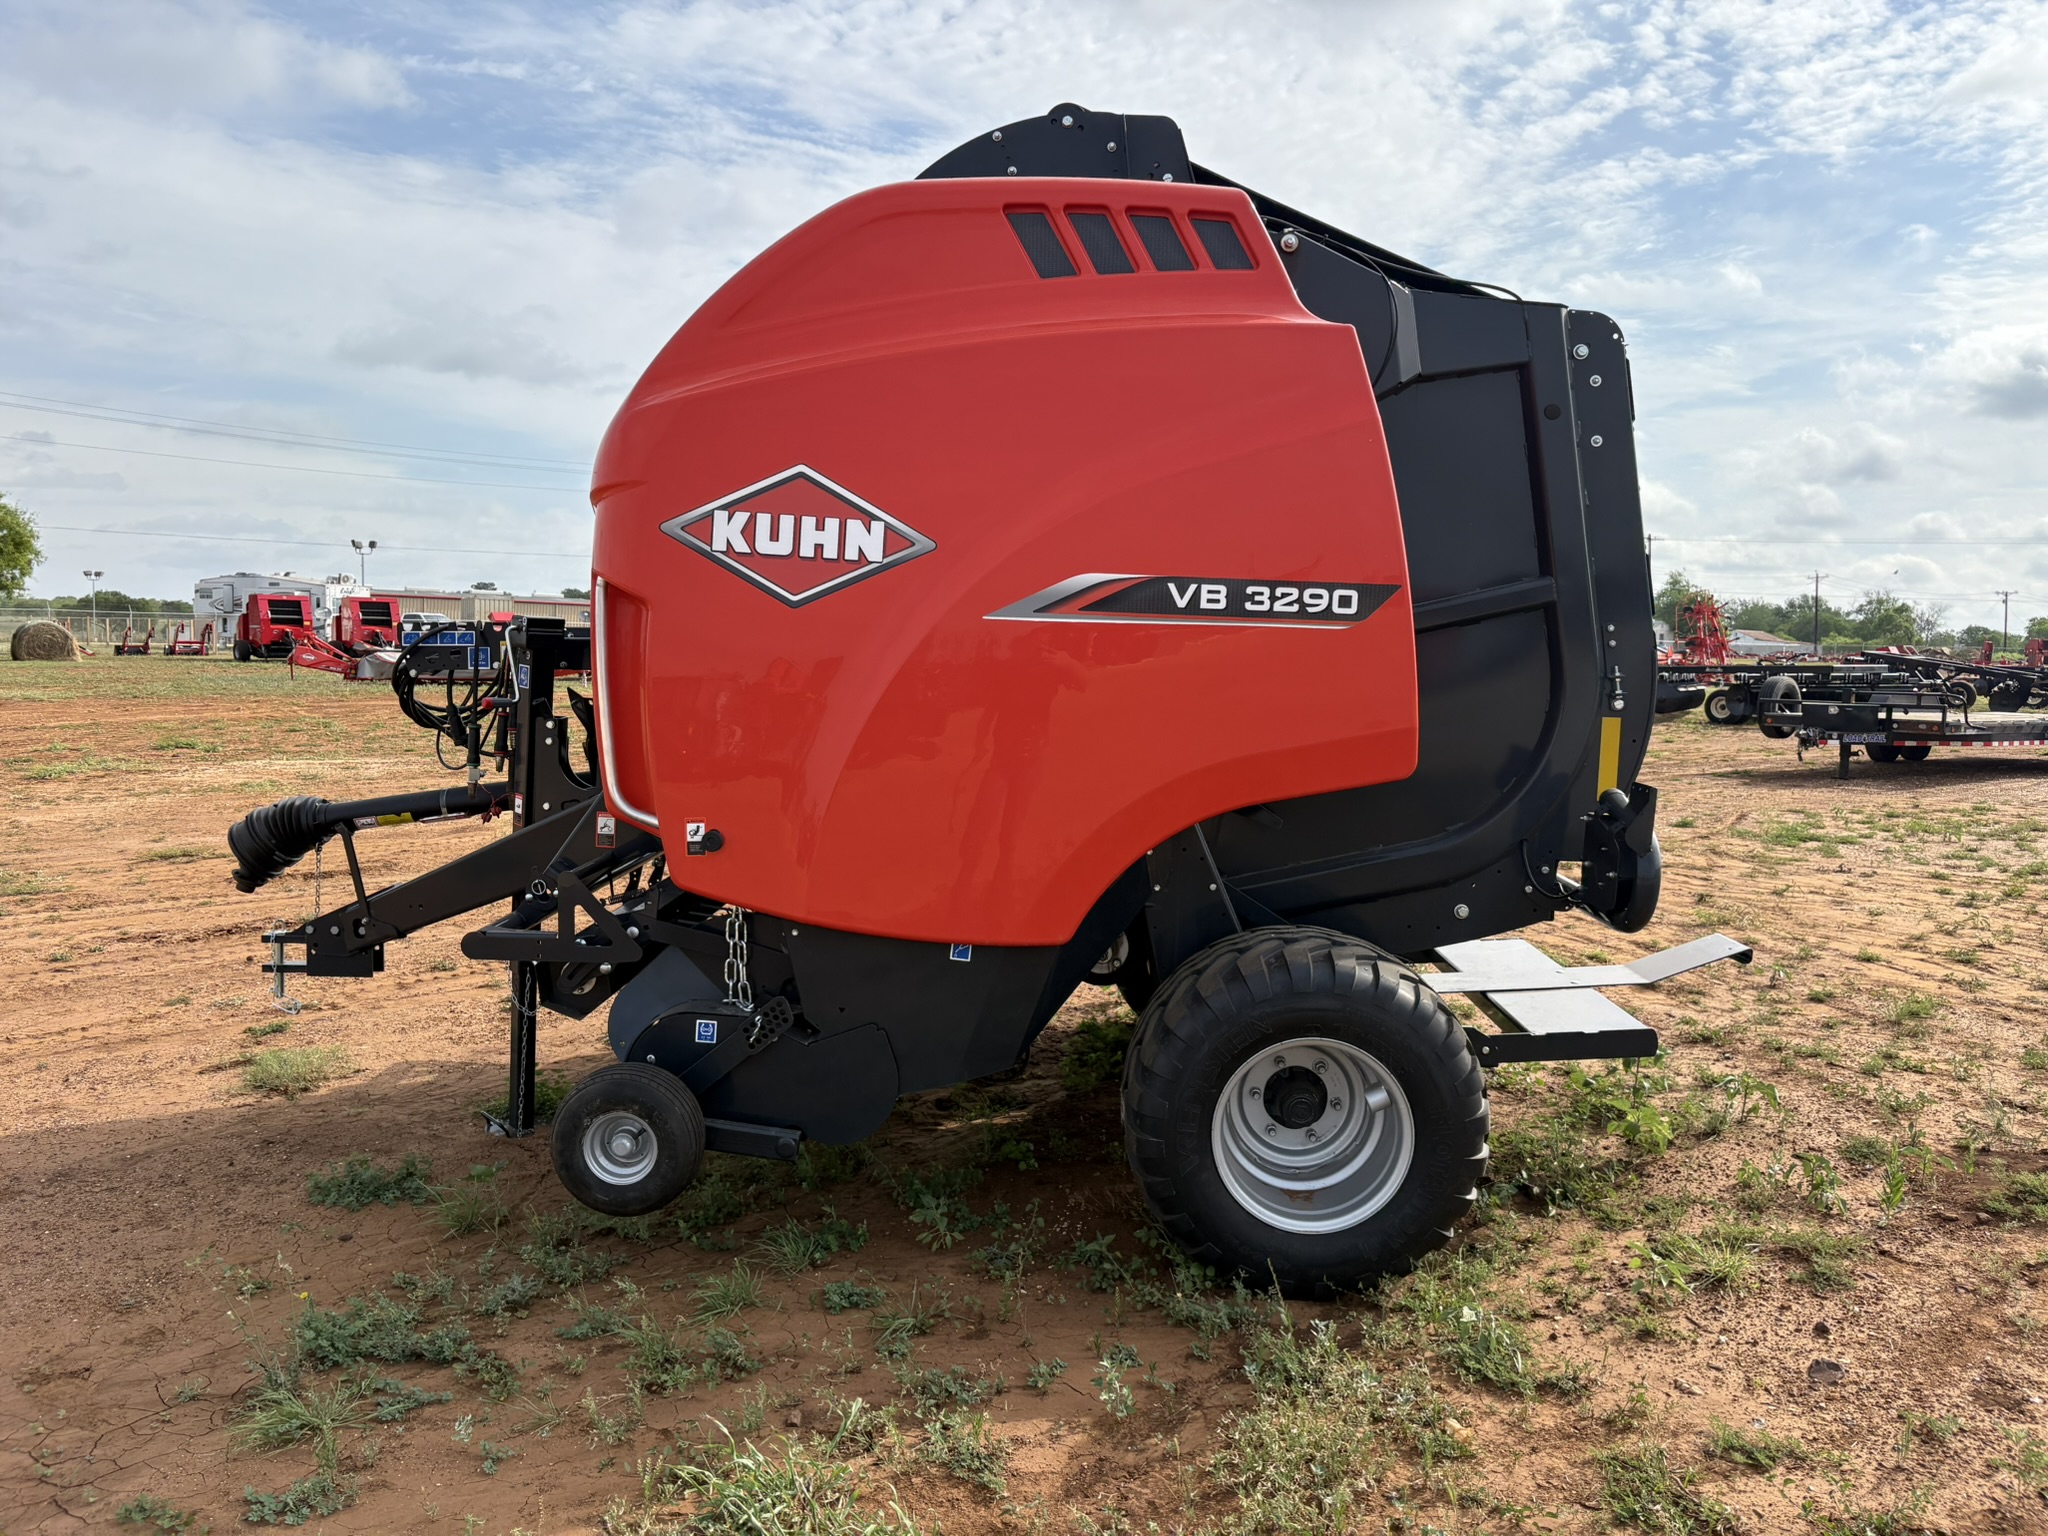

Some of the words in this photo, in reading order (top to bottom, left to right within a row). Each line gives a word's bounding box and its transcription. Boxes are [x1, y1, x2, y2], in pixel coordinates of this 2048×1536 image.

[711, 509, 886, 563] KUHN
[1167, 582, 1228, 610] VB
[1244, 585, 1359, 615] 3290
[1842, 733, 1863, 743] LOAD
[1866, 733, 1887, 744] TRAIL
